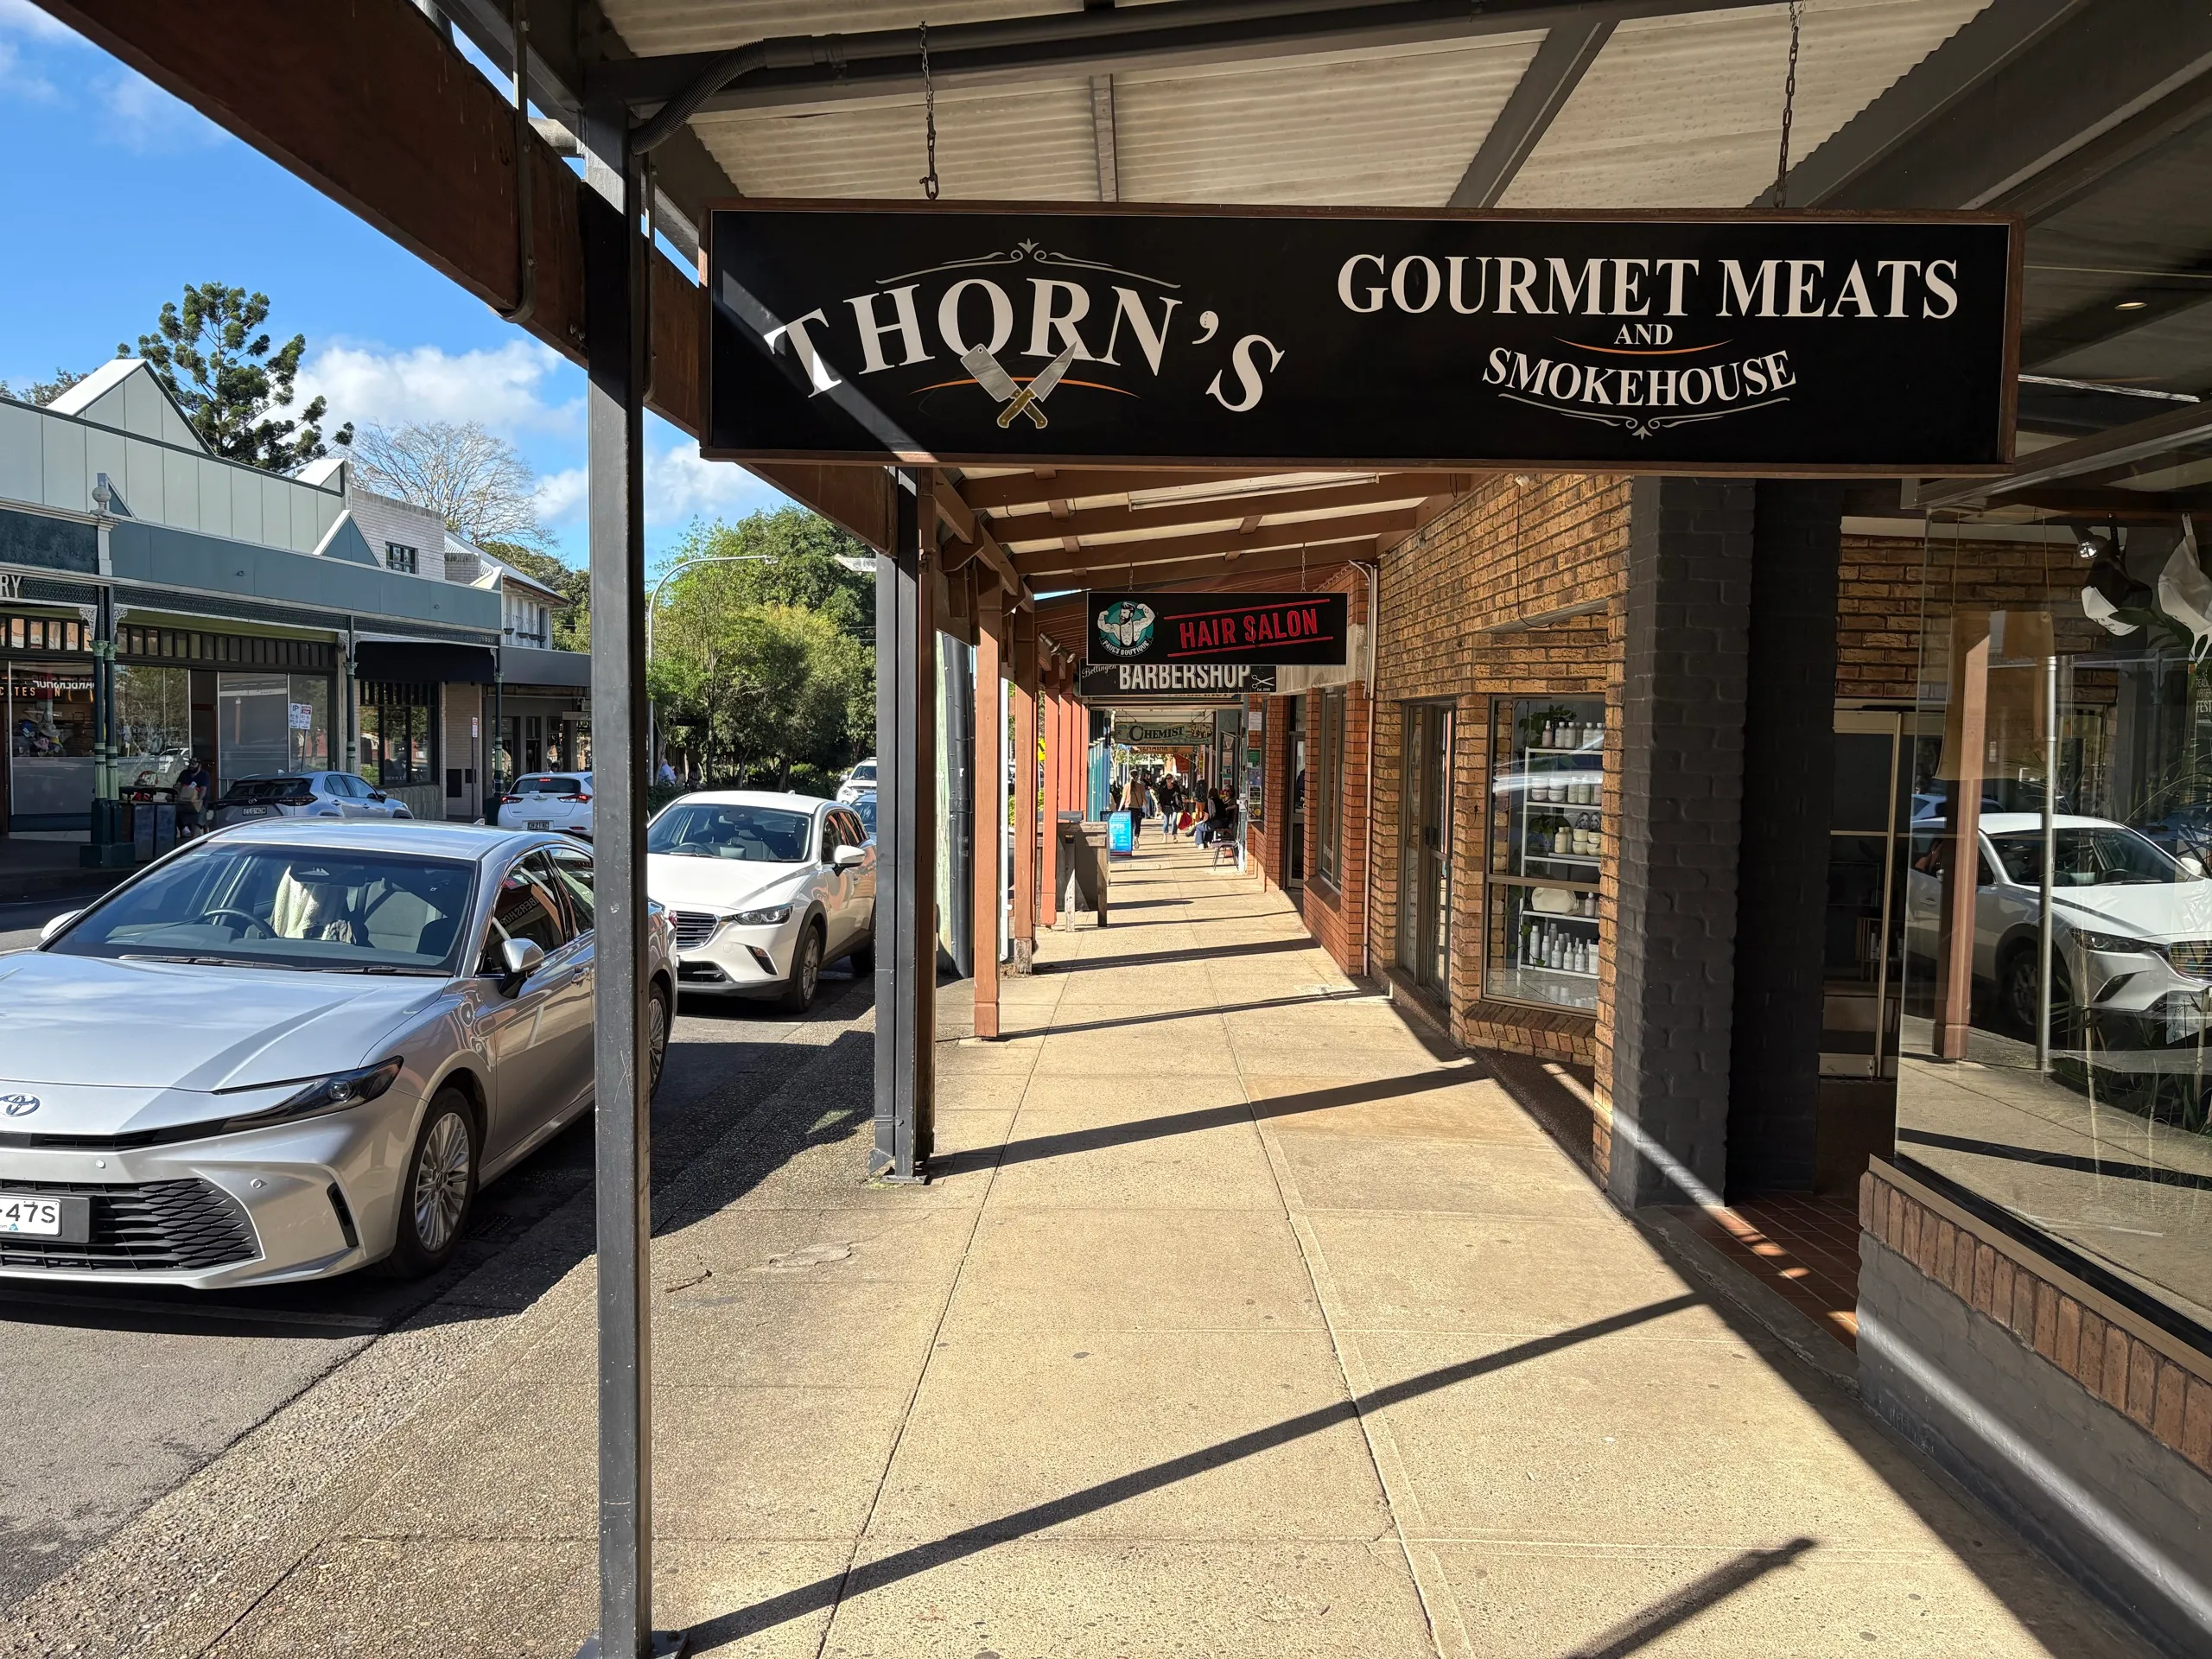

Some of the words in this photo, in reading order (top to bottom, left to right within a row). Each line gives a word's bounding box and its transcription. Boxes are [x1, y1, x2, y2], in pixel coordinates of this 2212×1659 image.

[1337, 253, 1700, 317] GOURMET
[1717, 257, 1960, 321] MEATS
[764, 276, 1286, 413] THORN'S
[1613, 323, 1674, 346] AND
[1482, 346, 1797, 407] SMOKEHOUSE
[1120, 640, 1150, 656] BOUTIQUE
[1179, 617, 1236, 649] HAIR
[1243, 608, 1318, 642] SALON
[1119, 664, 1250, 690] BARBERSHOP
